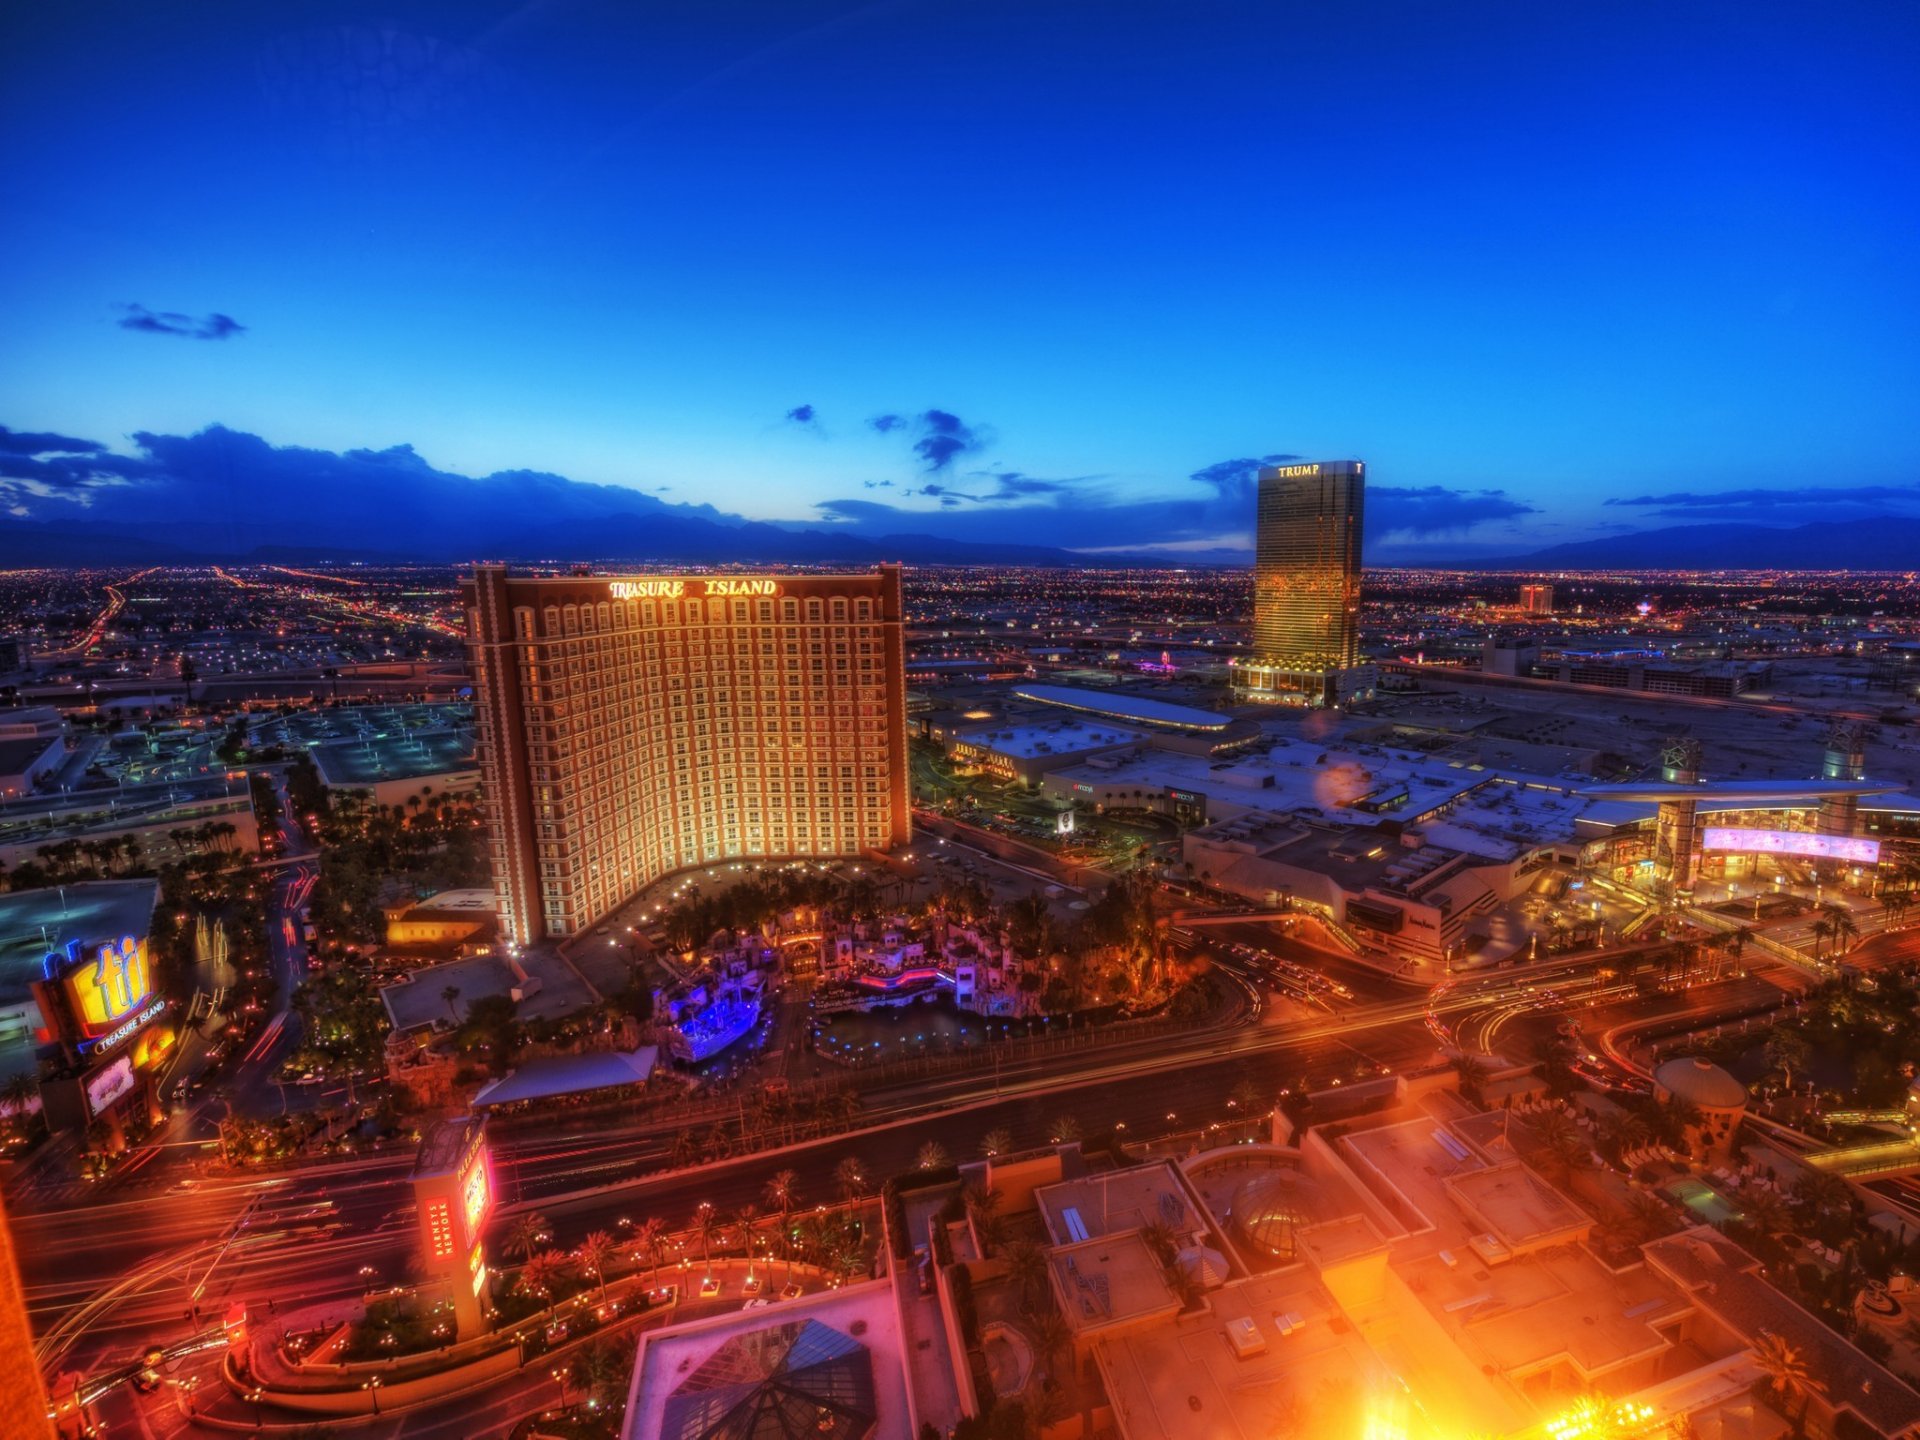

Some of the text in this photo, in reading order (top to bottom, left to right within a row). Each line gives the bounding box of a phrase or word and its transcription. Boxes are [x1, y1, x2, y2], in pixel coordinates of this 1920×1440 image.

[1278, 464, 1319, 477] TRUMP
[609, 580, 776, 599] TREASURE ISLAND
[100, 1000, 165, 1050] TREASURE ISLAND
[457, 1131, 483, 1181] PALAZZO
[429, 1205, 444, 1257] BARNEYS
